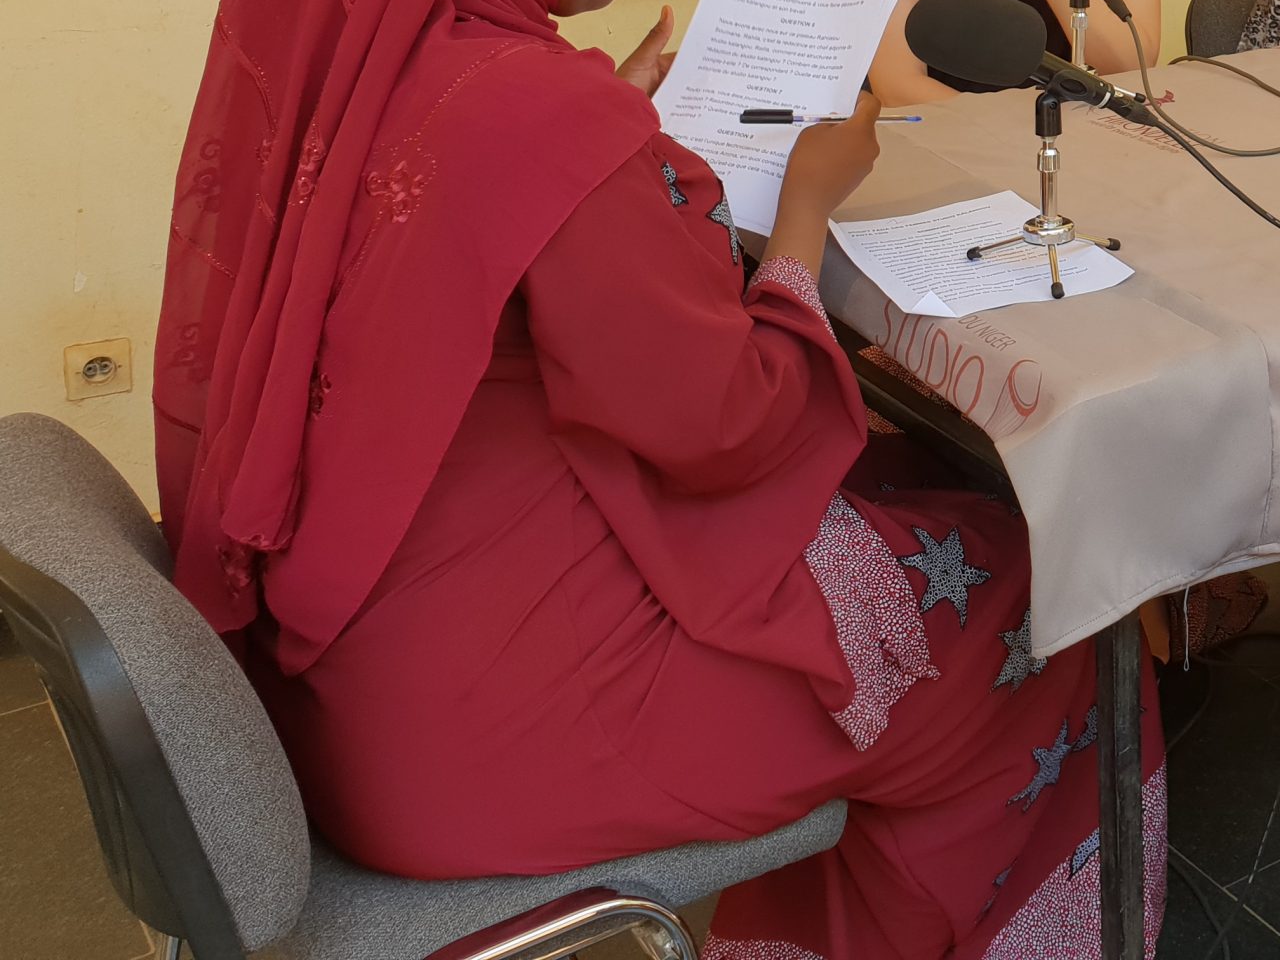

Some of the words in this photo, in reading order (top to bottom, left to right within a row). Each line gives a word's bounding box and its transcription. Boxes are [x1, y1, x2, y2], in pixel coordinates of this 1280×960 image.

[780, 16, 811, 27] QUESTION
[746, 83, 778, 94] QUESTION
[717, 128, 749, 139] QUESTION
[957, 314, 981, 330] DU
[977, 323, 1017, 352] NIGER
